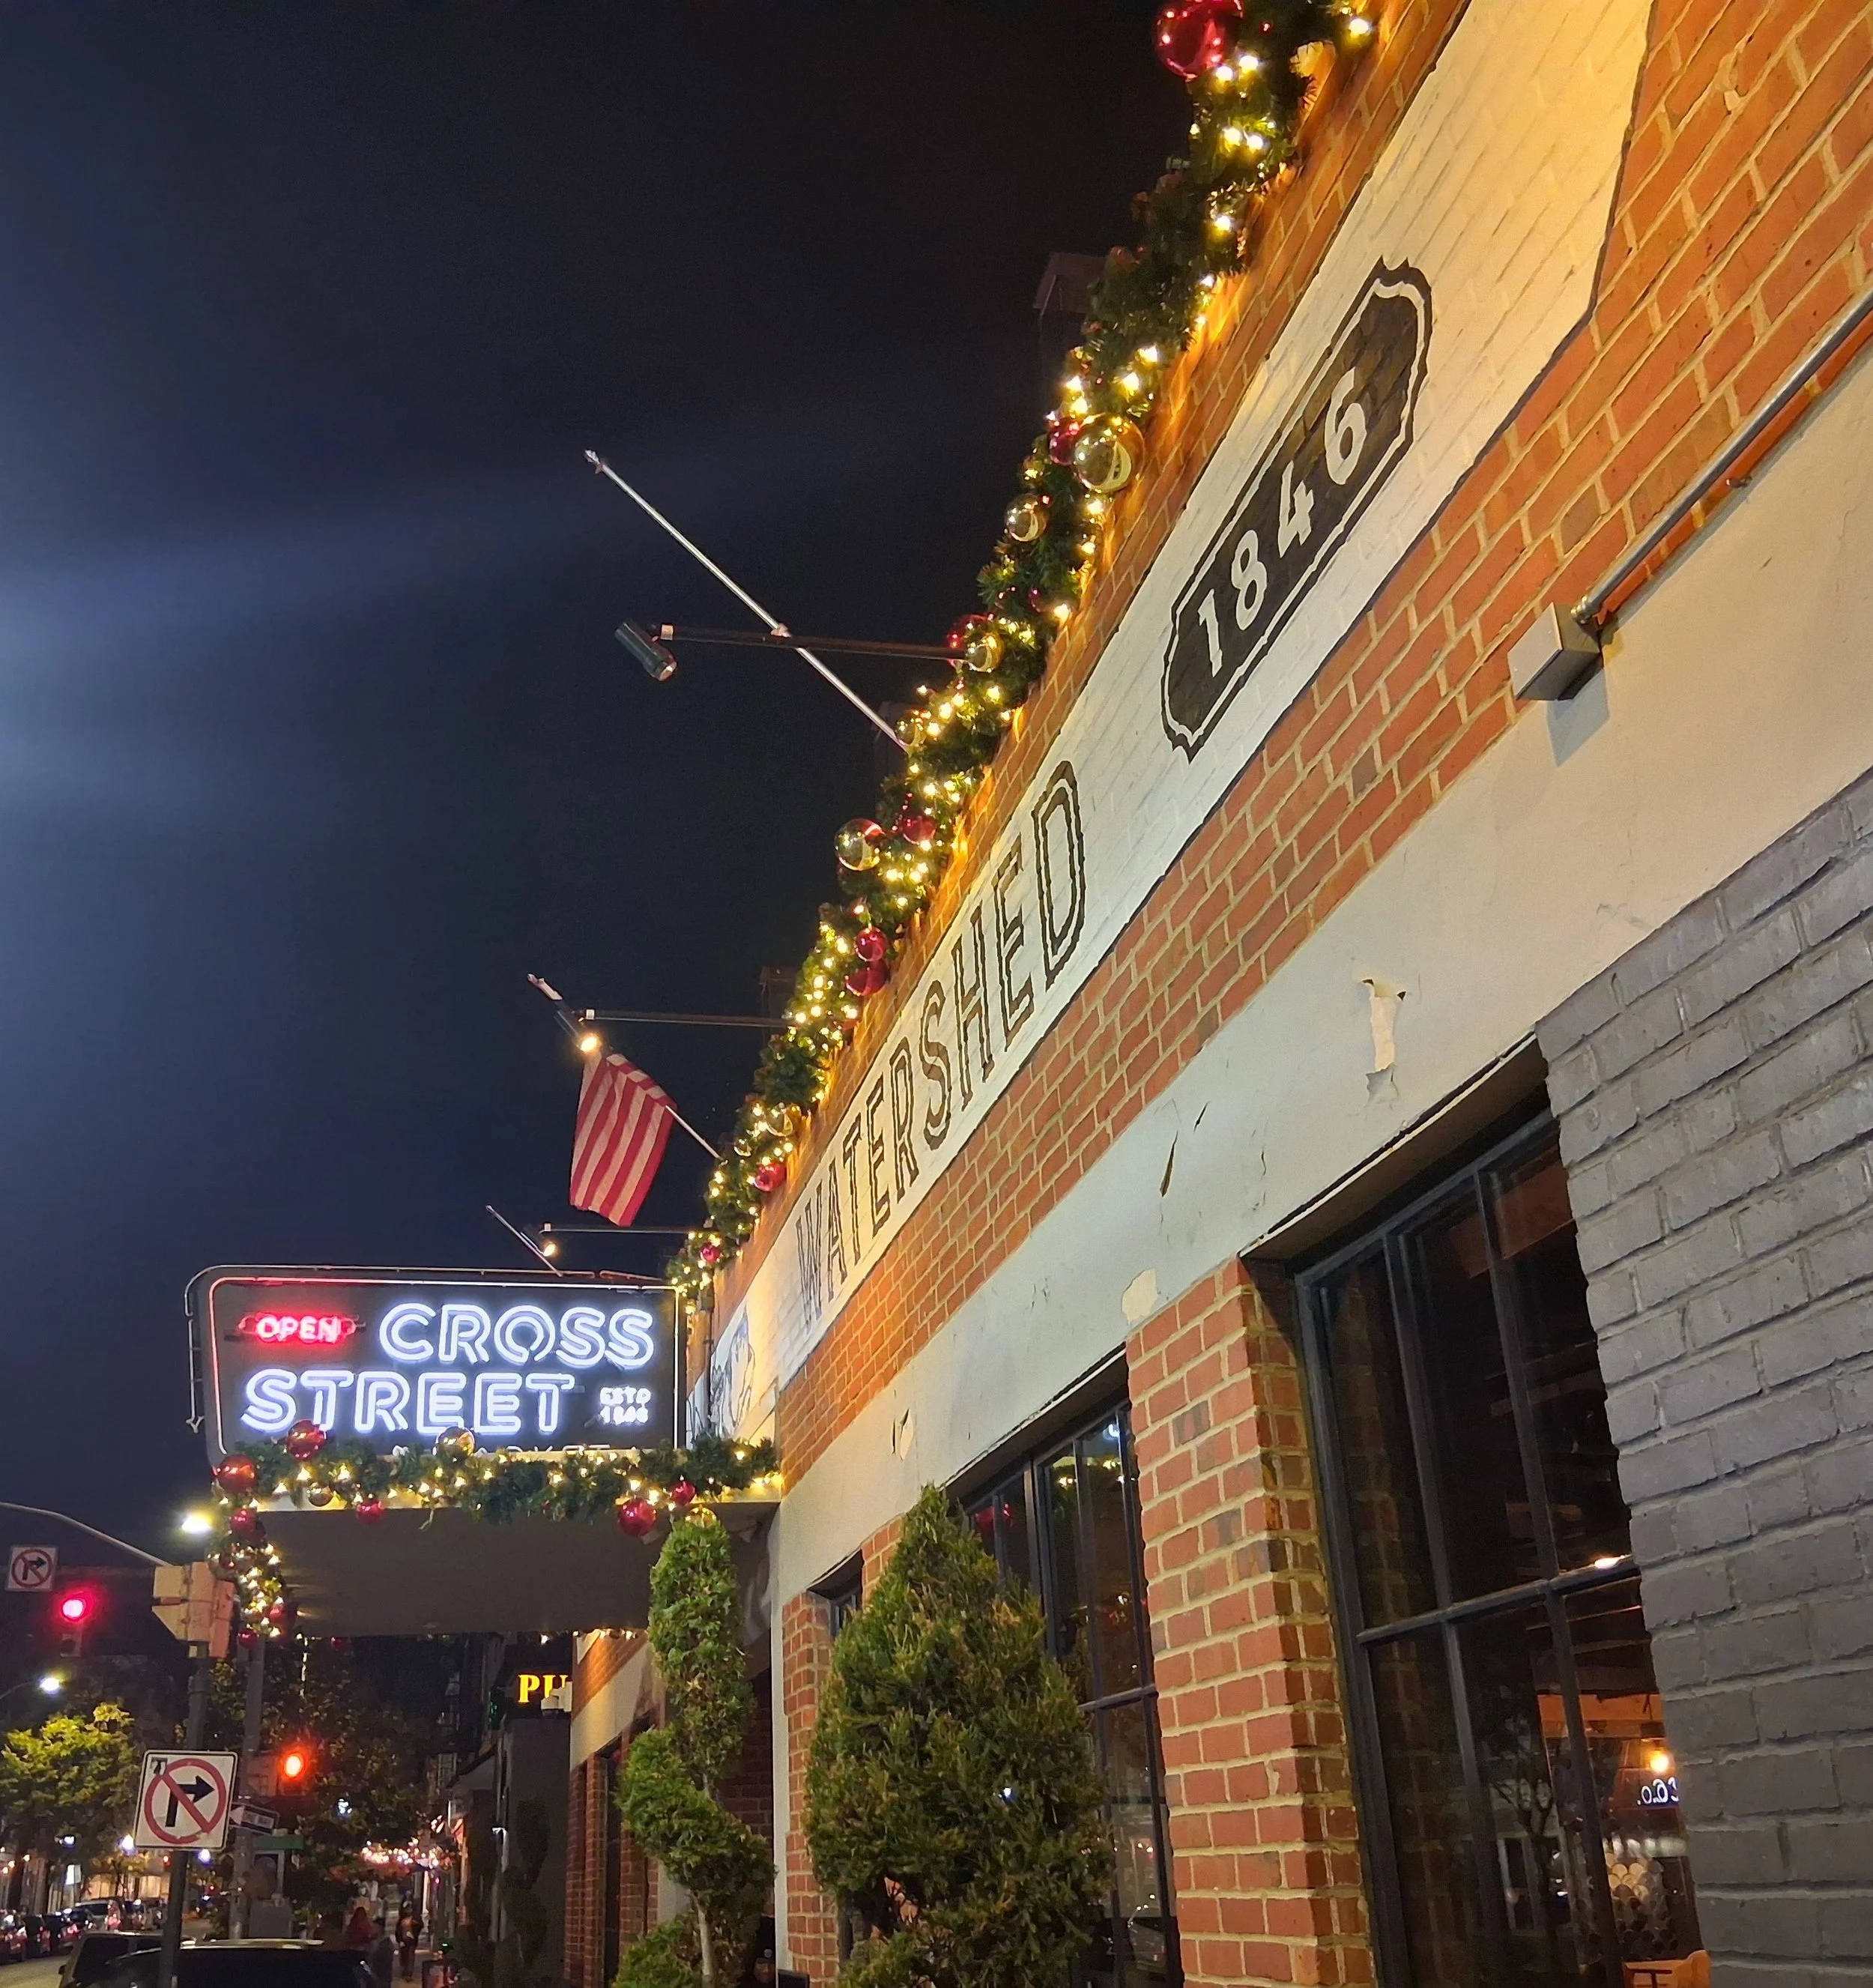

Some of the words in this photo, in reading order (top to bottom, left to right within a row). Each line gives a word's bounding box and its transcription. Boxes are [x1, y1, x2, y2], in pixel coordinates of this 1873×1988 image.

[1197, 366, 1367, 677] 1846
[795, 760, 1087, 1326] WATERSHED
[256, 1314, 341, 1343] OPEN
[378, 1302, 656, 1368] CROSS
[240, 1368, 576, 1436] STREET
